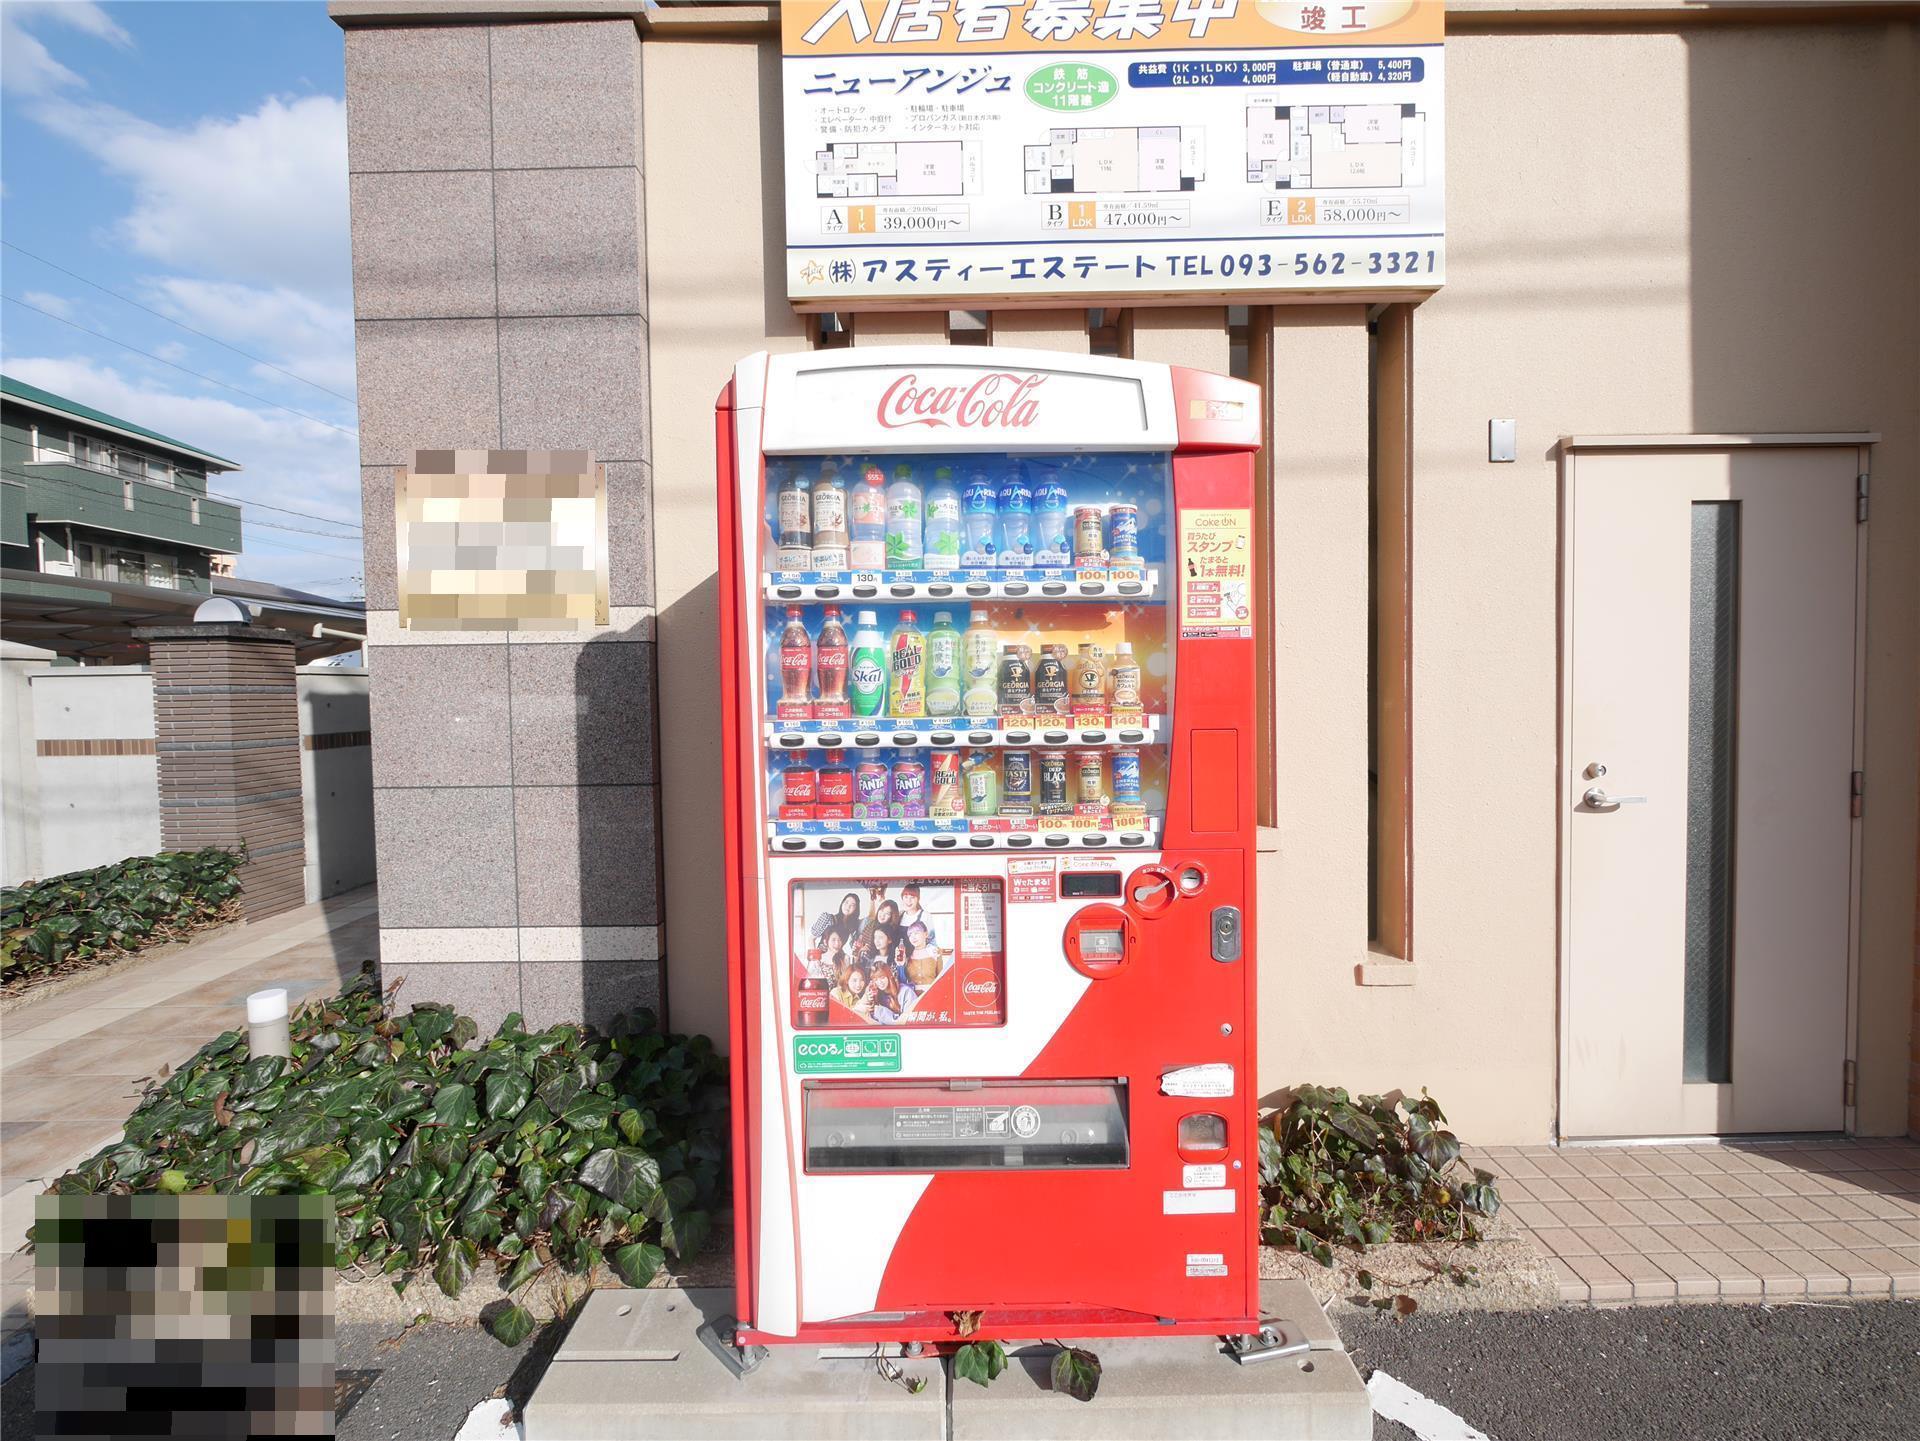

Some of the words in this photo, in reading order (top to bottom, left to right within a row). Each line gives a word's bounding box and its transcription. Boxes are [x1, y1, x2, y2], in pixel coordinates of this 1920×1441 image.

[1138, 64, 1167, 75] 共益費
[1242, 62, 1276, 73] 3,000円
[1292, 60, 1322, 72] 駐車場
[1378, 59, 1411, 71] 5,400円
[803, 65, 1011, 96] ニューアンジュ
[1242, 74, 1276, 85] 4,000円
[1378, 71, 1411, 83] 4,320円
[1048, 204, 1063, 220] B
[1078, 203, 1086, 215] 1
[1267, 200, 1282, 216] E
[1296, 200, 1307, 213] 2
[827, 209, 843, 225] A
[857, 208, 865, 221] 1
[1291, 214, 1313, 223] LDK
[858, 222, 866, 231] K
[1072, 218, 1093, 227] LDK
[1166, 255, 1213, 276] TEL
[877, 373, 1050, 429] Coca-Cola
[1195, 518, 1220, 527] Coke
[1187, 540, 1234, 553] スタンプ
[1199, 556, 1229, 564] たまると
[892, 645, 921, 661] REAL
[893, 655, 922, 672] GOLD
[1002, 680, 1029, 689] GEORGIA
[1038, 680, 1065, 688] GEORGIA
[1005, 770, 1028, 778] TASTY
[859, 778, 884, 790] FANTA
[896, 778, 920, 790] FANTA
[964, 981, 998, 994] Coca-Cola
